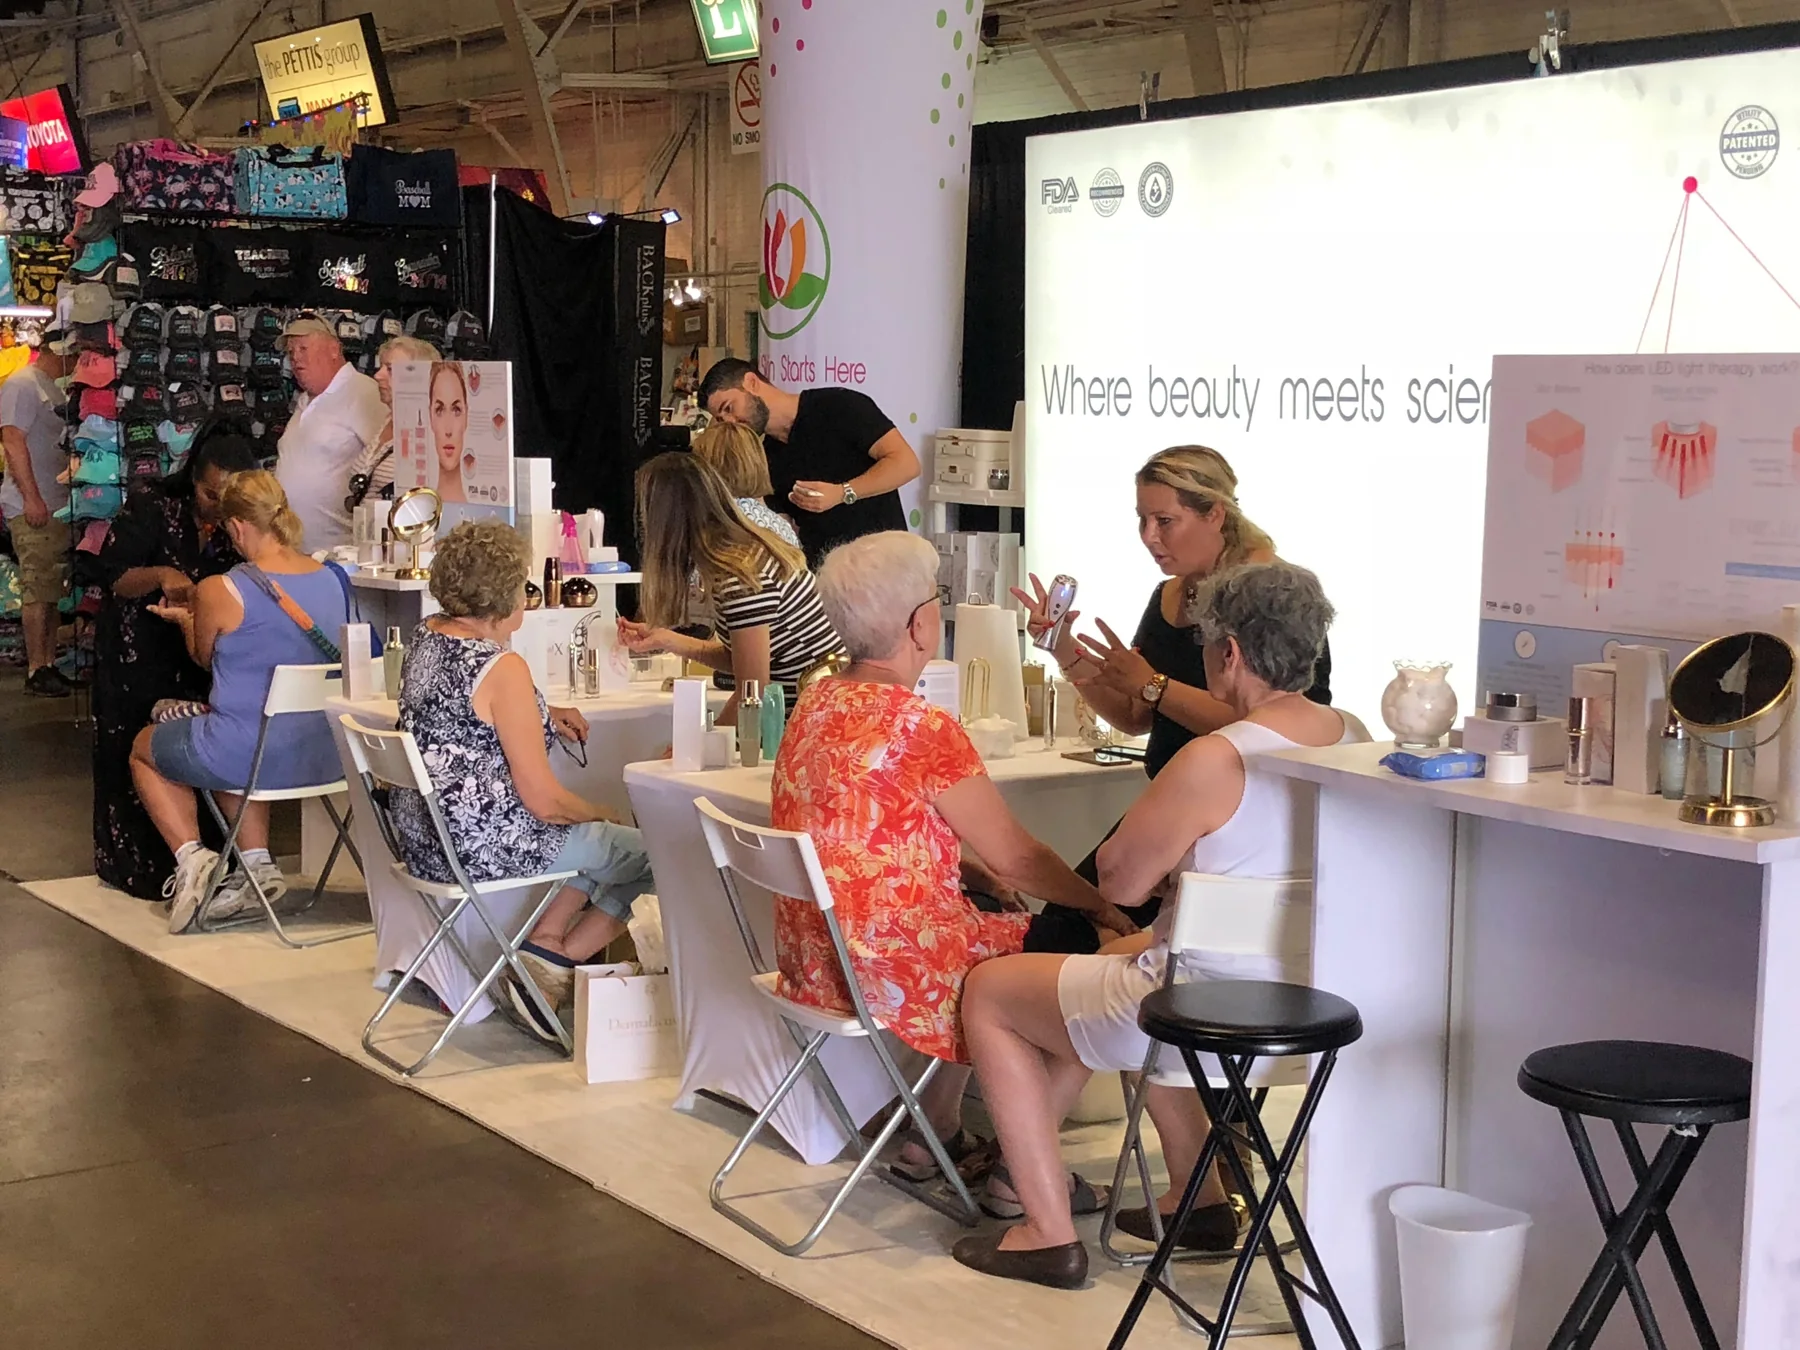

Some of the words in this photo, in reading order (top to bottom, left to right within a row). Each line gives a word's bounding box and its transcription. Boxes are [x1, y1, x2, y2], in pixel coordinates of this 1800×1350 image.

[264, 54, 283, 79] the
[282, 44, 323, 75] PETTIS
[324, 43, 360, 75] group
[27, 119, 68, 148] TOYOTA
[733, 132, 742, 146] NO
[1723, 134, 1776, 150] PATENTED
[1041, 176, 1080, 205] FDA
[781, 354, 816, 383] Starts
[824, 355, 867, 385] Here
[1041, 364, 1132, 417] Where
[1149, 364, 1260, 432] beauty
[1280, 364, 1385, 423] meets
